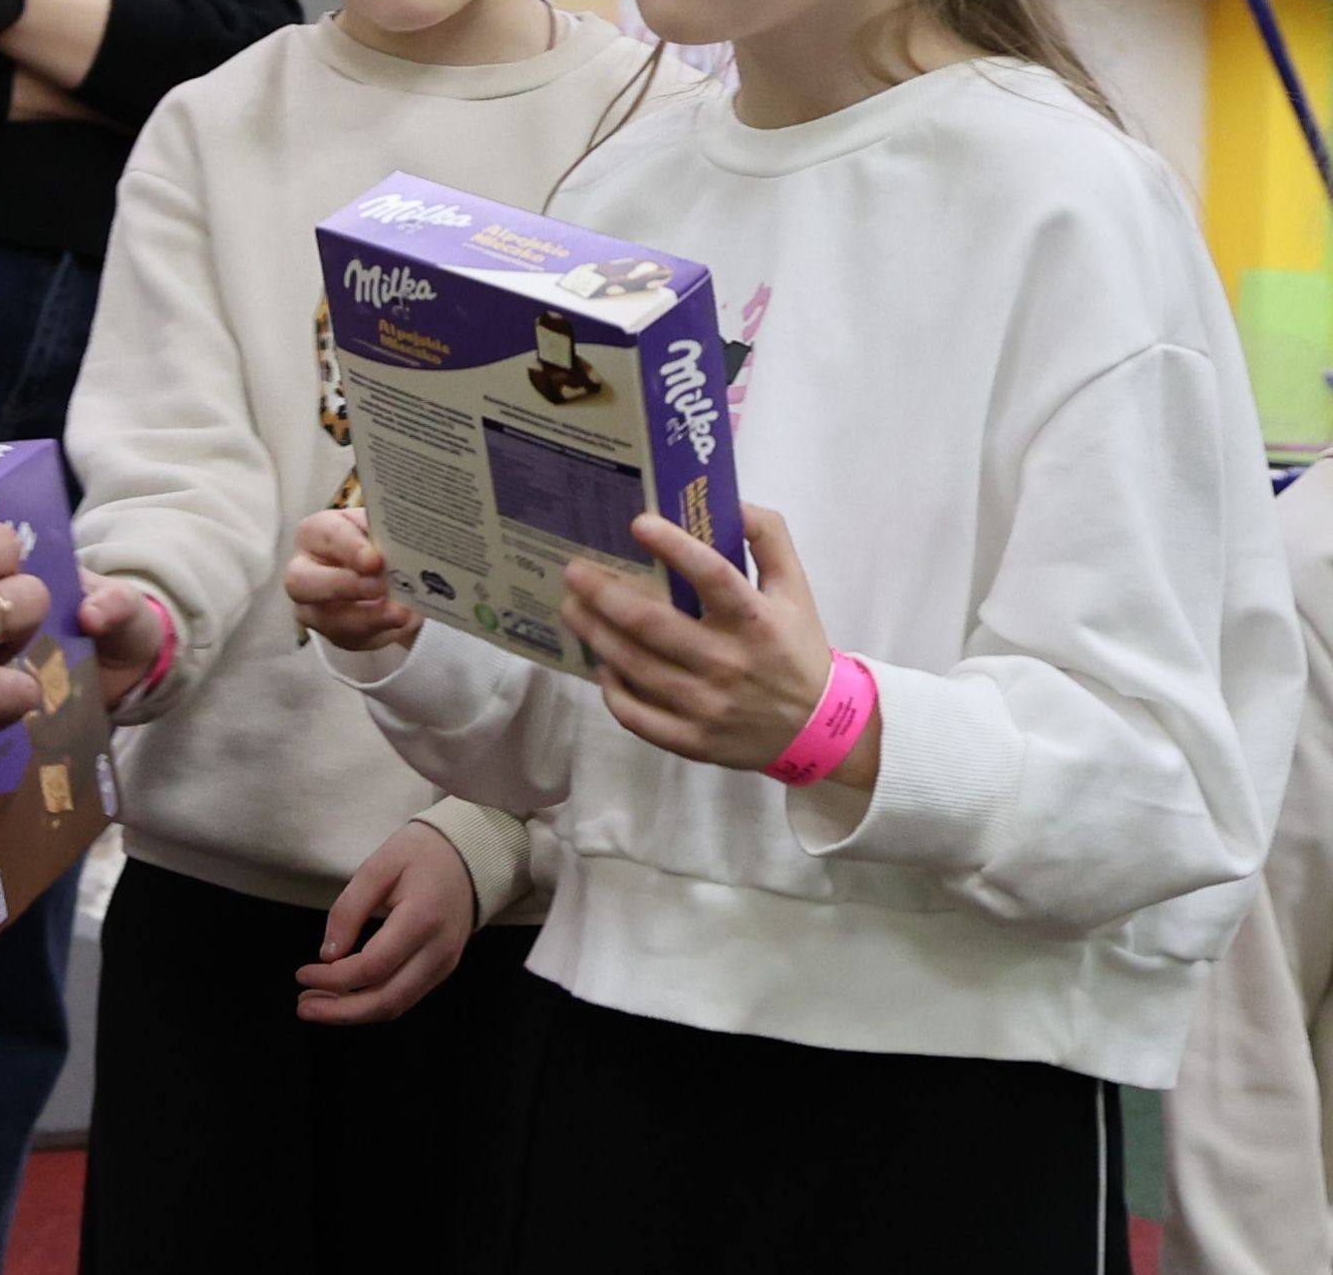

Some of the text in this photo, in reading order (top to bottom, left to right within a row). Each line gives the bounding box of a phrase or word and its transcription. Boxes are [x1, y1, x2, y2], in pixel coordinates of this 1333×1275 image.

[357, 193, 474, 228] Milka
[343, 259, 437, 309] Milka
[659, 339, 720, 465] Milka
